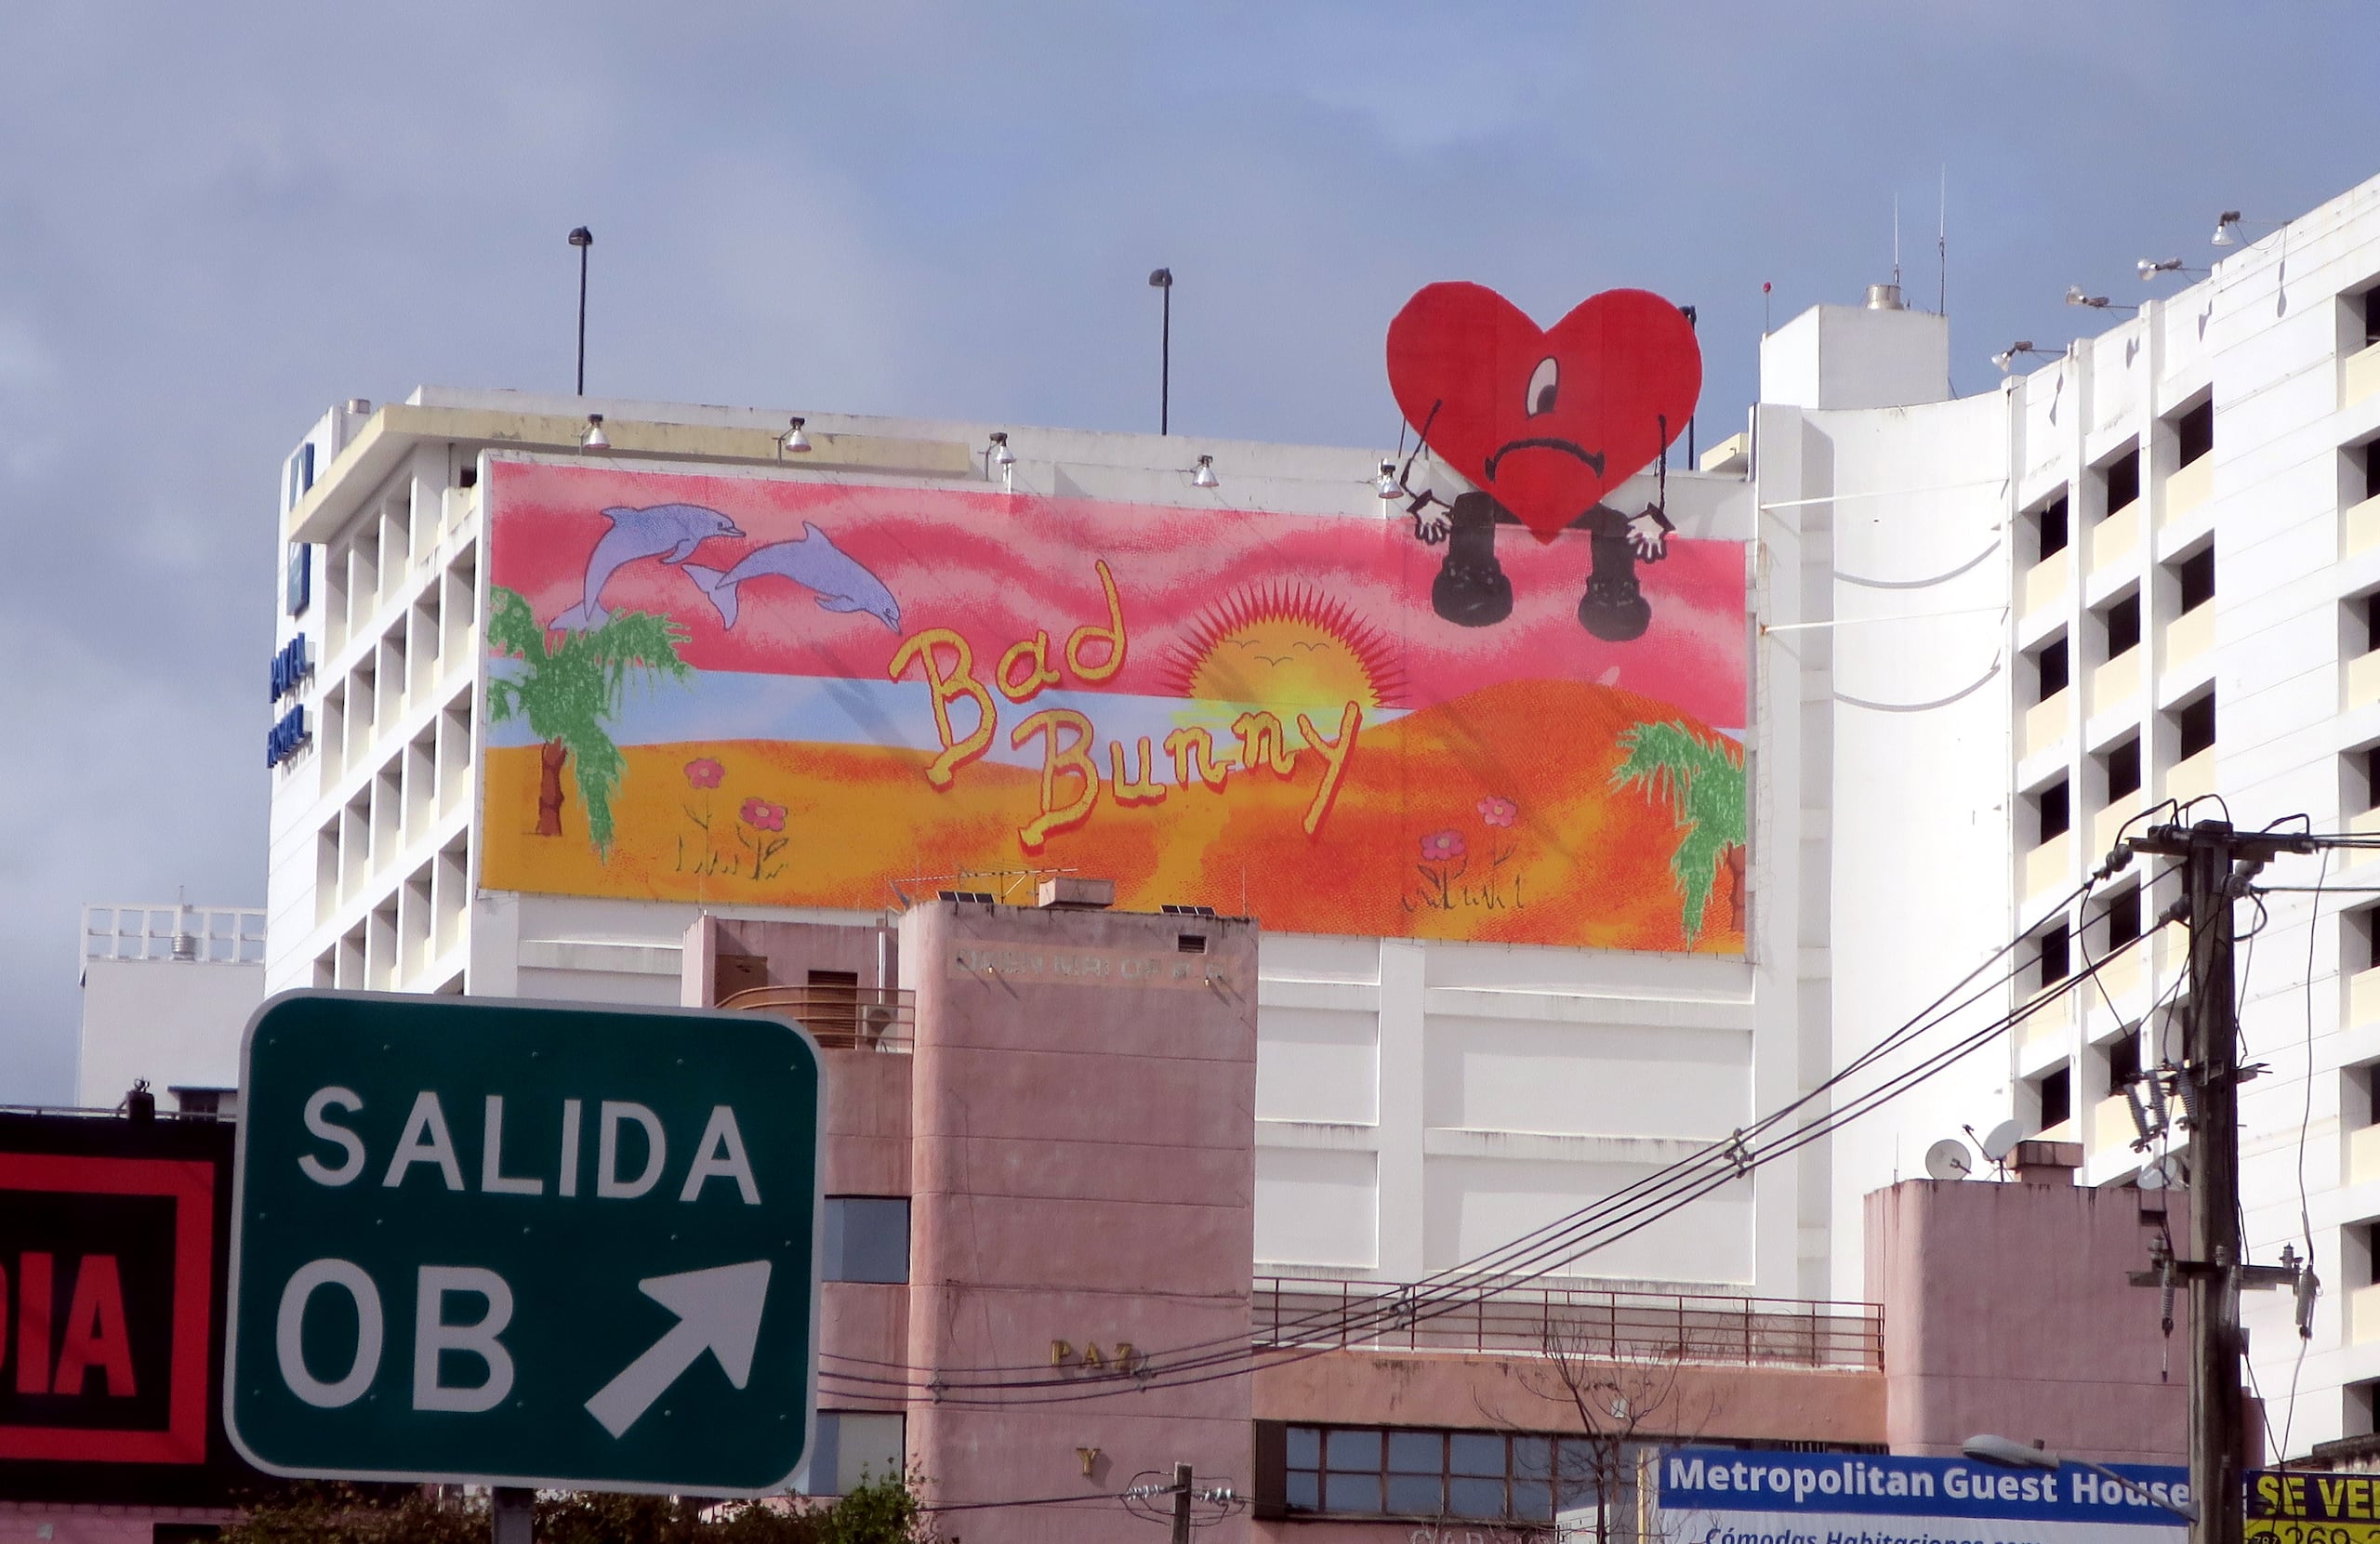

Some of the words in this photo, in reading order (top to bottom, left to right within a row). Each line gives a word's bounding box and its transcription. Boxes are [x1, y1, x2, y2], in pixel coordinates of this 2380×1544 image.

[889, 560, 1128, 788] Bad
[1012, 700, 1363, 855] Bunny
[298, 1086, 761, 1206] SALIDA
[0, 1251, 137, 1396] IA
[276, 1259, 514, 1413] OB
[1051, 1339, 1133, 1372] PAZ
[1077, 1447, 1101, 1477] Y
[1670, 1458, 1934, 1502] Metropolitan
[1943, 1467, 2057, 1502] Guest
[2072, 1473, 2189, 1508] House
[2257, 1475, 2306, 1515] SE
